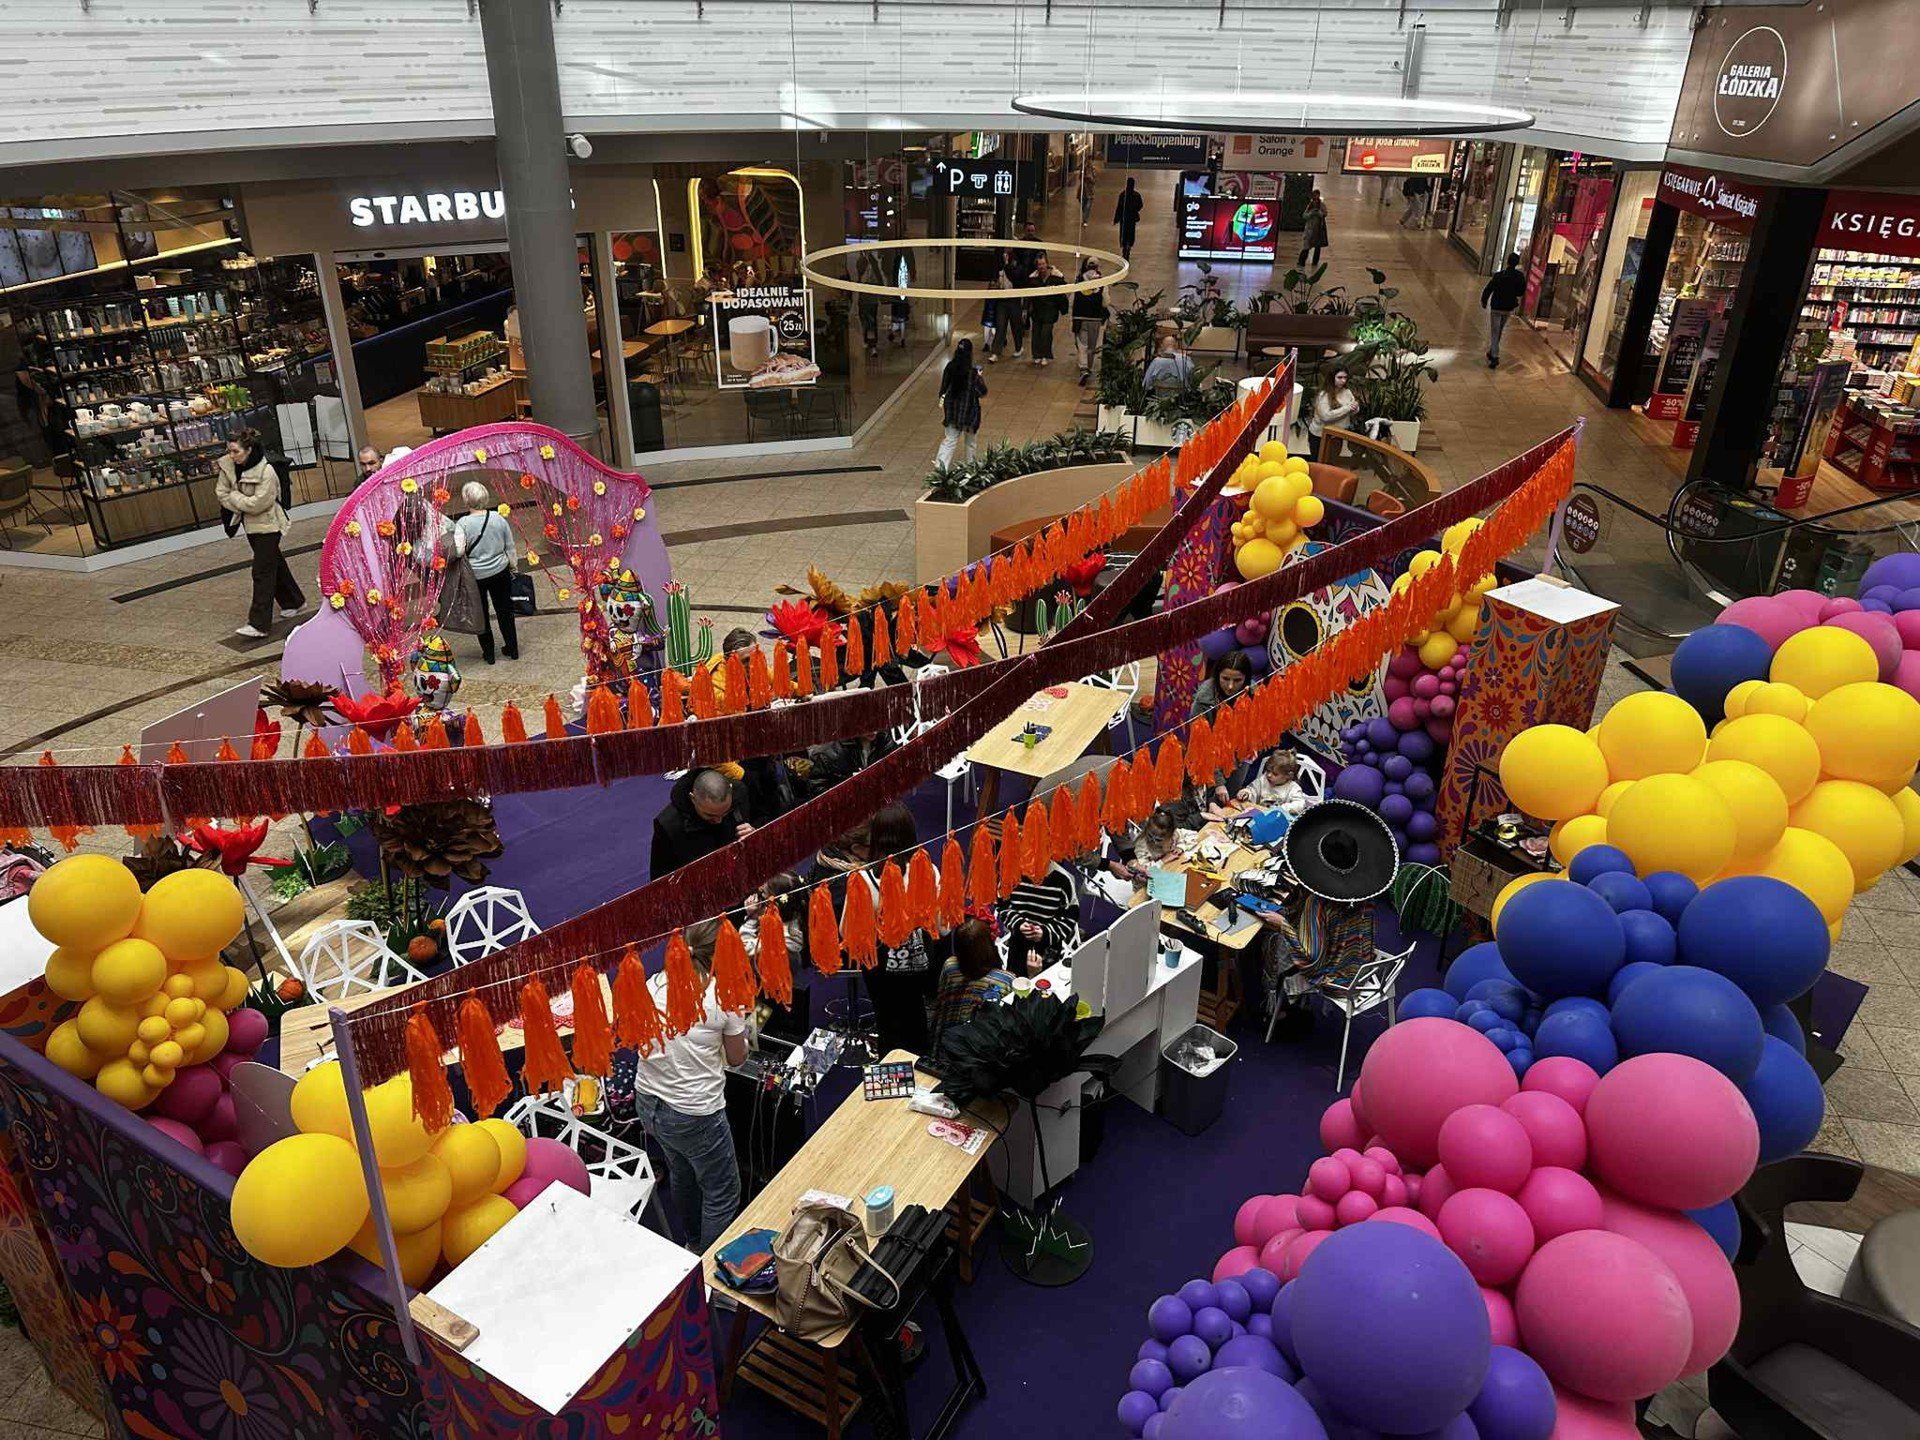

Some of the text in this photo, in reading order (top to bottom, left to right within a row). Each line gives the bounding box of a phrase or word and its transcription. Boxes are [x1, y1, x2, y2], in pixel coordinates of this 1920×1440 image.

[1730, 64, 1772, 79] GALERIA
[1718, 74, 1779, 99] ŁÓDZKA
[1257, 145, 1294, 157] Orange
[949, 168, 965, 193] P
[1663, 171, 1703, 197] KSIĘGARNIE
[1830, 212, 1920, 239] KSIĘG
[736, 286, 790, 298] IDEALNIE
[722, 297, 804, 310] DOPASOWANI
[782, 320, 795, 331] 25
